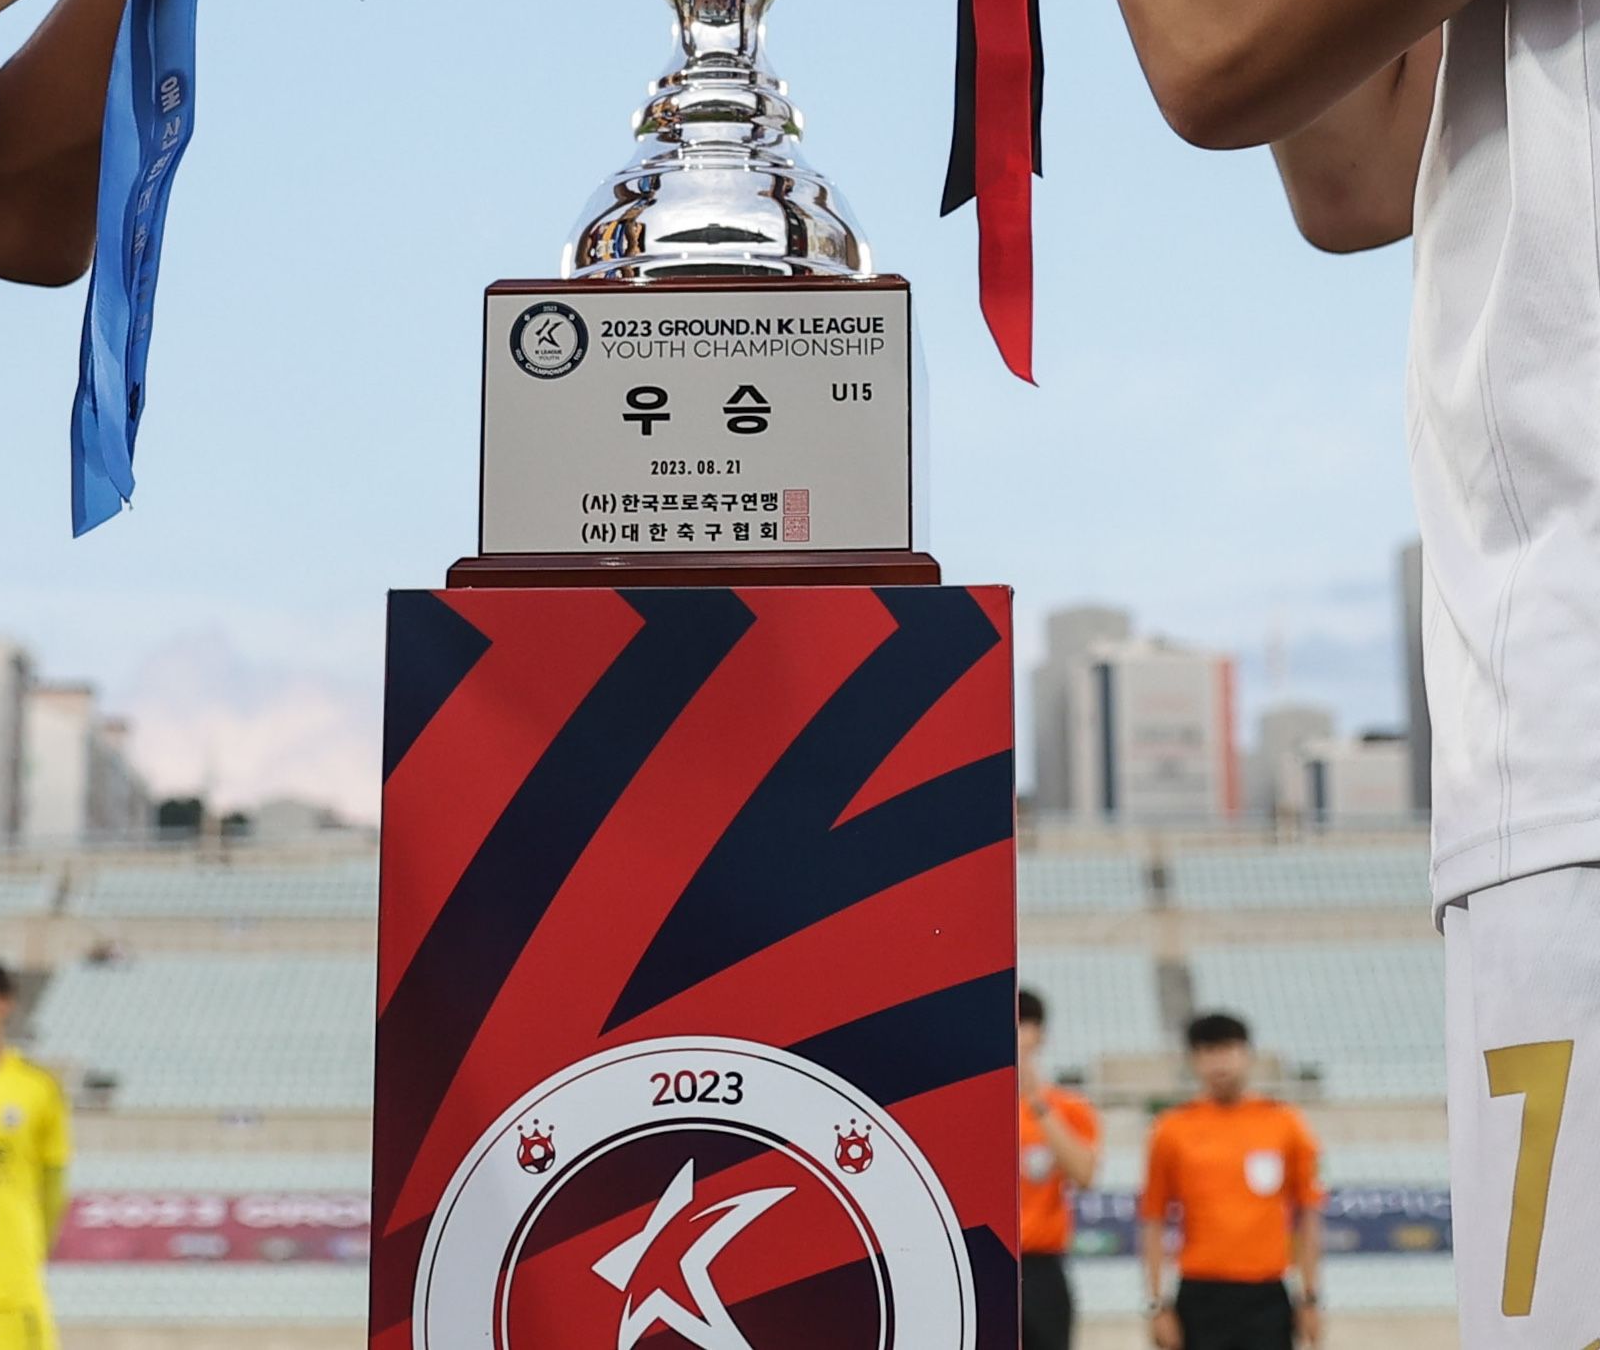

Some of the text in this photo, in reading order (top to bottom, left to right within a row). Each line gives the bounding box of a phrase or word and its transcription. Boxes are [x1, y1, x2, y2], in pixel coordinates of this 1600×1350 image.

[601, 317, 884, 338] 2023 GROUND.N K LEAGUE
[601, 339, 685, 359] YOUTH
[693, 337, 884, 358] CHAMPIONSHIP
[832, 383, 872, 401] U15
[650, 1070, 743, 1106] 2023
[1483, 1039, 1574, 1317] 7
